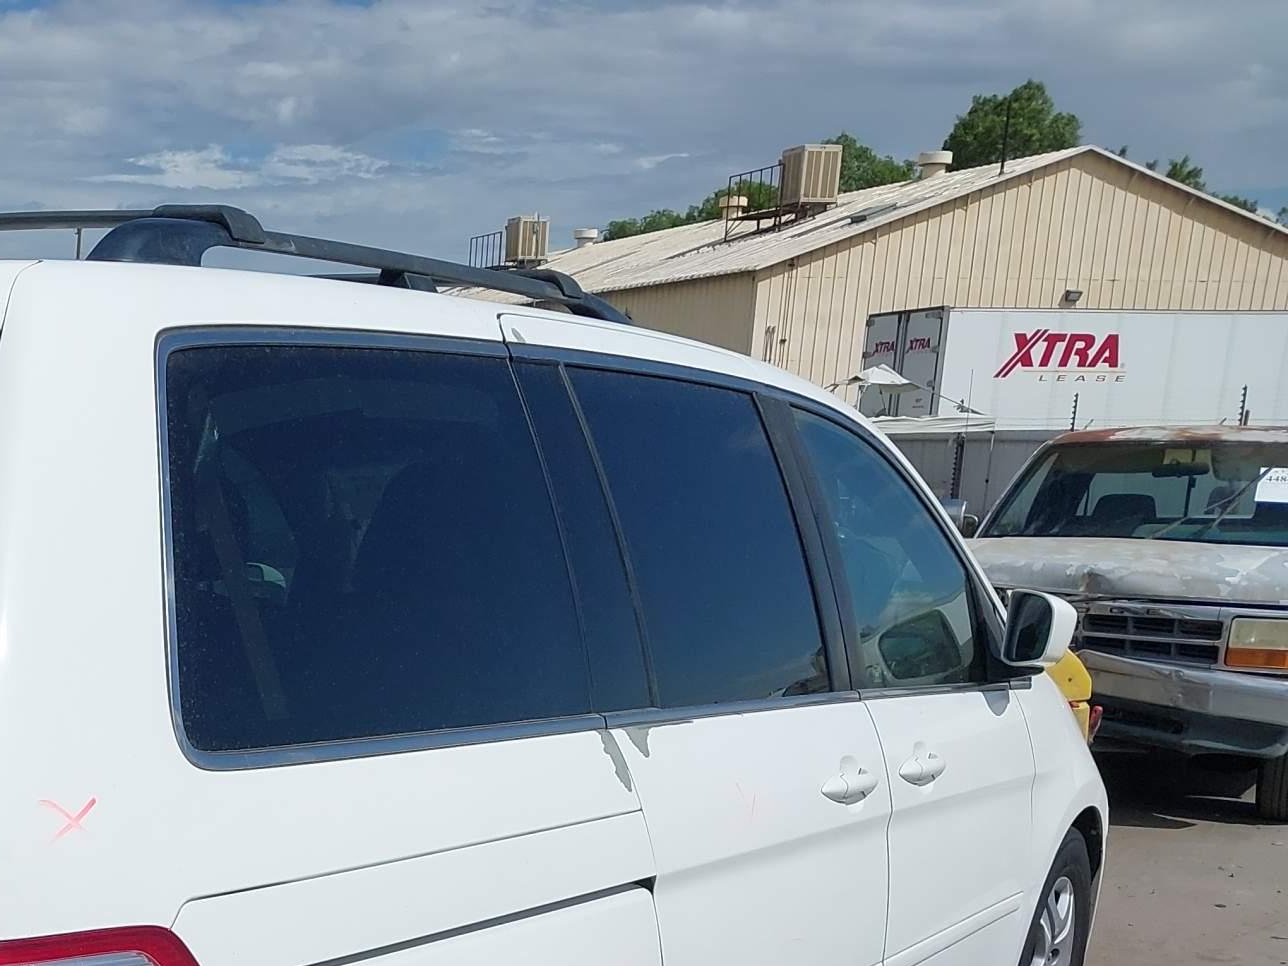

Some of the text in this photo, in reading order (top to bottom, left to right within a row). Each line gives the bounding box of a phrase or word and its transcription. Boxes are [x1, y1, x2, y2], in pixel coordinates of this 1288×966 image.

[872, 341, 896, 355] XTRA
[905, 337, 931, 353] XTRA
[993, 329, 1120, 378] XTRA
[1038, 374, 1126, 382] LEASE
